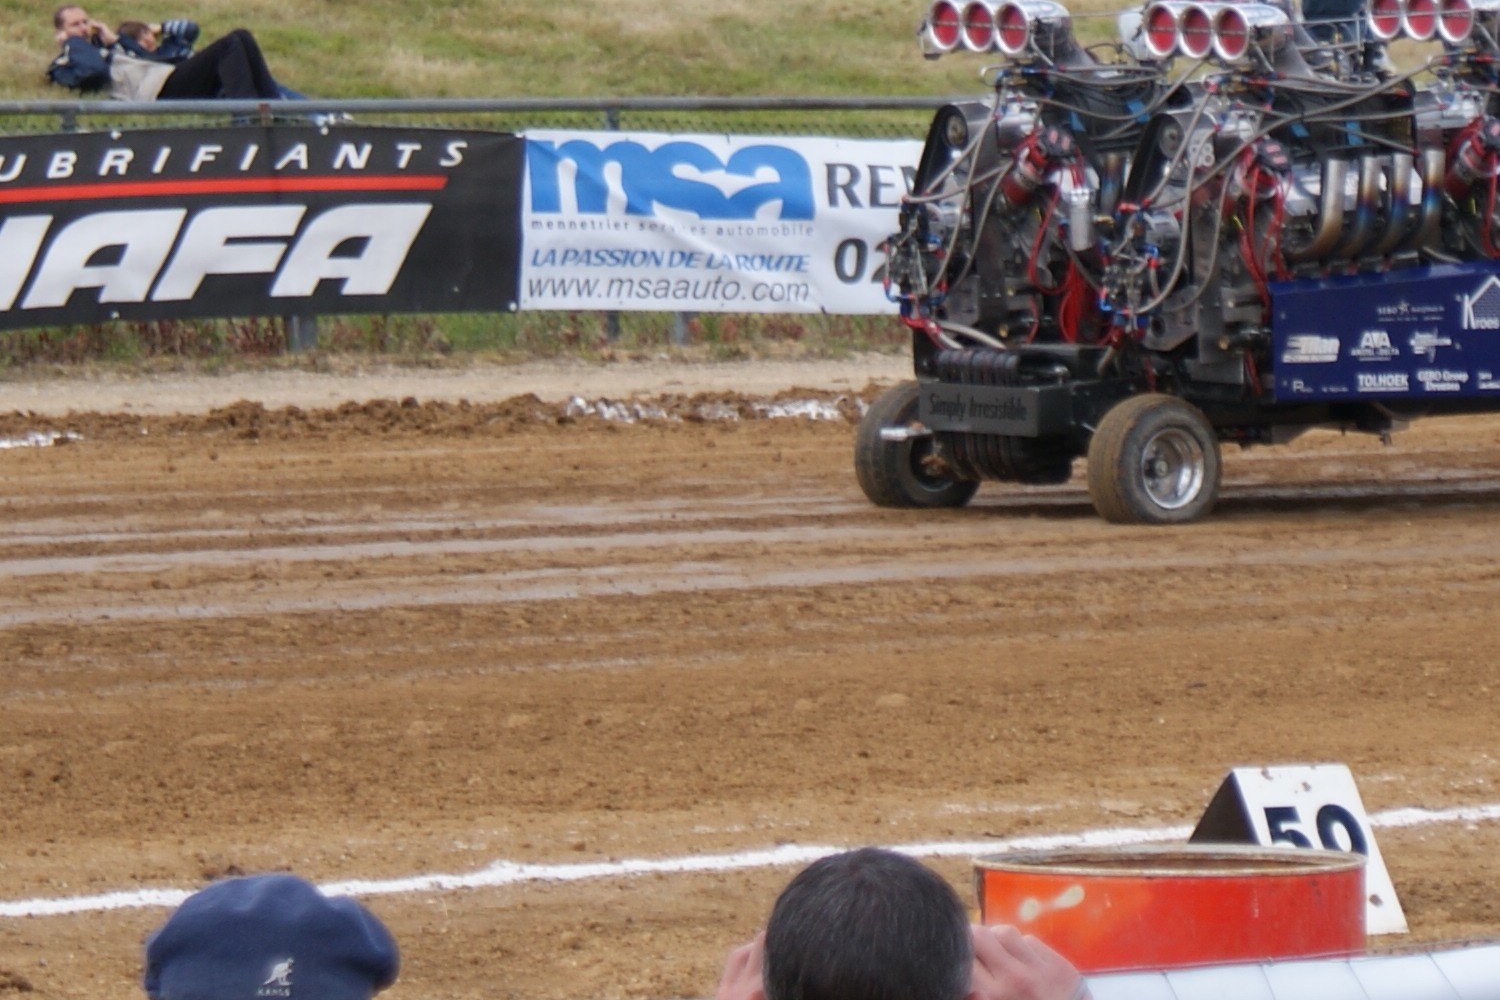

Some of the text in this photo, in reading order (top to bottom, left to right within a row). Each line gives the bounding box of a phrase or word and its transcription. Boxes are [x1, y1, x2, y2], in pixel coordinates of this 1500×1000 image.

[525, 139, 816, 221] msa
[716, 223, 814, 237] automobile
[0, 203, 433, 312] AFA
[561, 249, 664, 269] PASSION
[668, 249, 698, 270] DE
[735, 254, 811, 274] ROUTE
[528, 275, 810, 303] www.msaauto.com
[1357, 374, 1409, 387] TOLHOEK
[1263, 804, 1368, 857] 50
